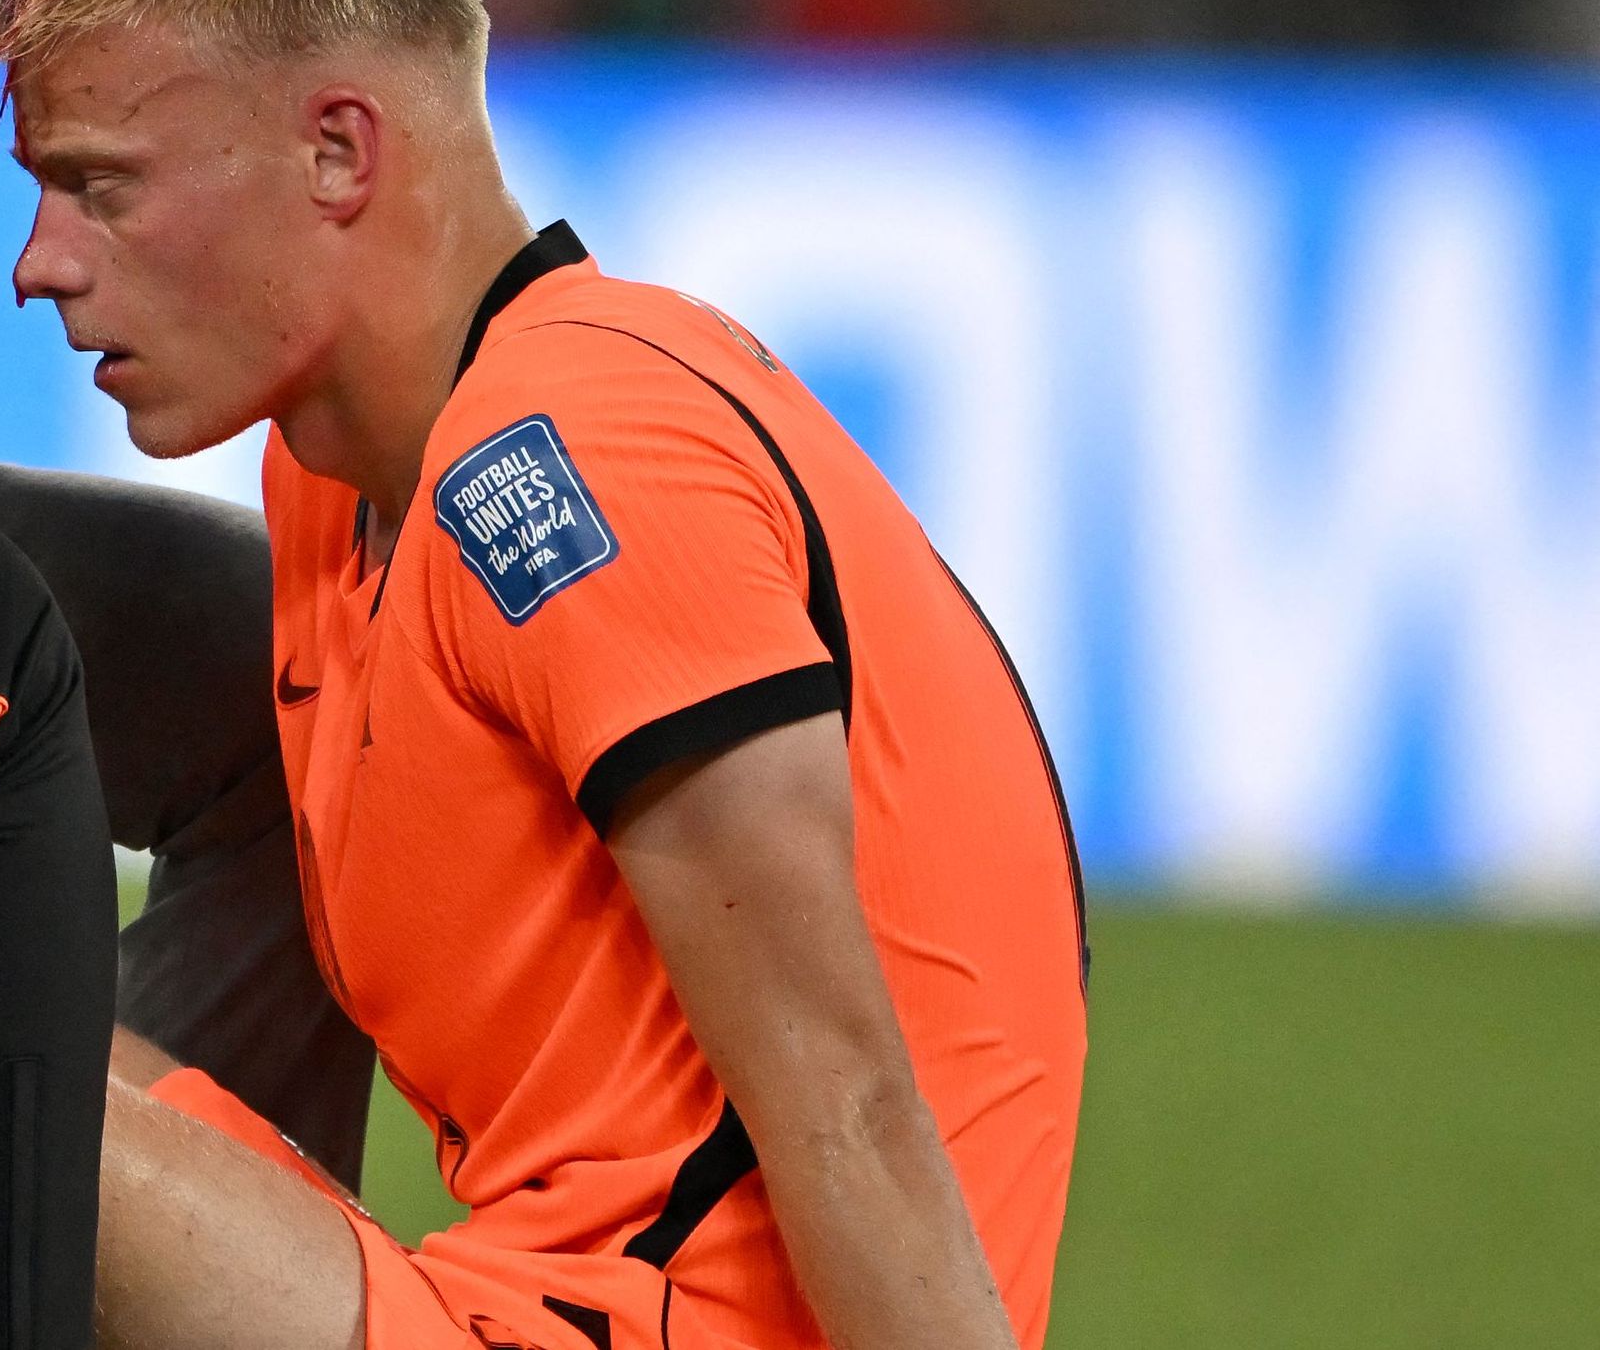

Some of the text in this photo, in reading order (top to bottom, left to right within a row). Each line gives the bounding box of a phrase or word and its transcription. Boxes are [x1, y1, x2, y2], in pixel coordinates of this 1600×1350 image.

[452, 446, 540, 517] FOOTBALL
[465, 468, 555, 544] UNITES
[487, 496, 577, 576] the World
[524, 547, 558, 576] FIFA
